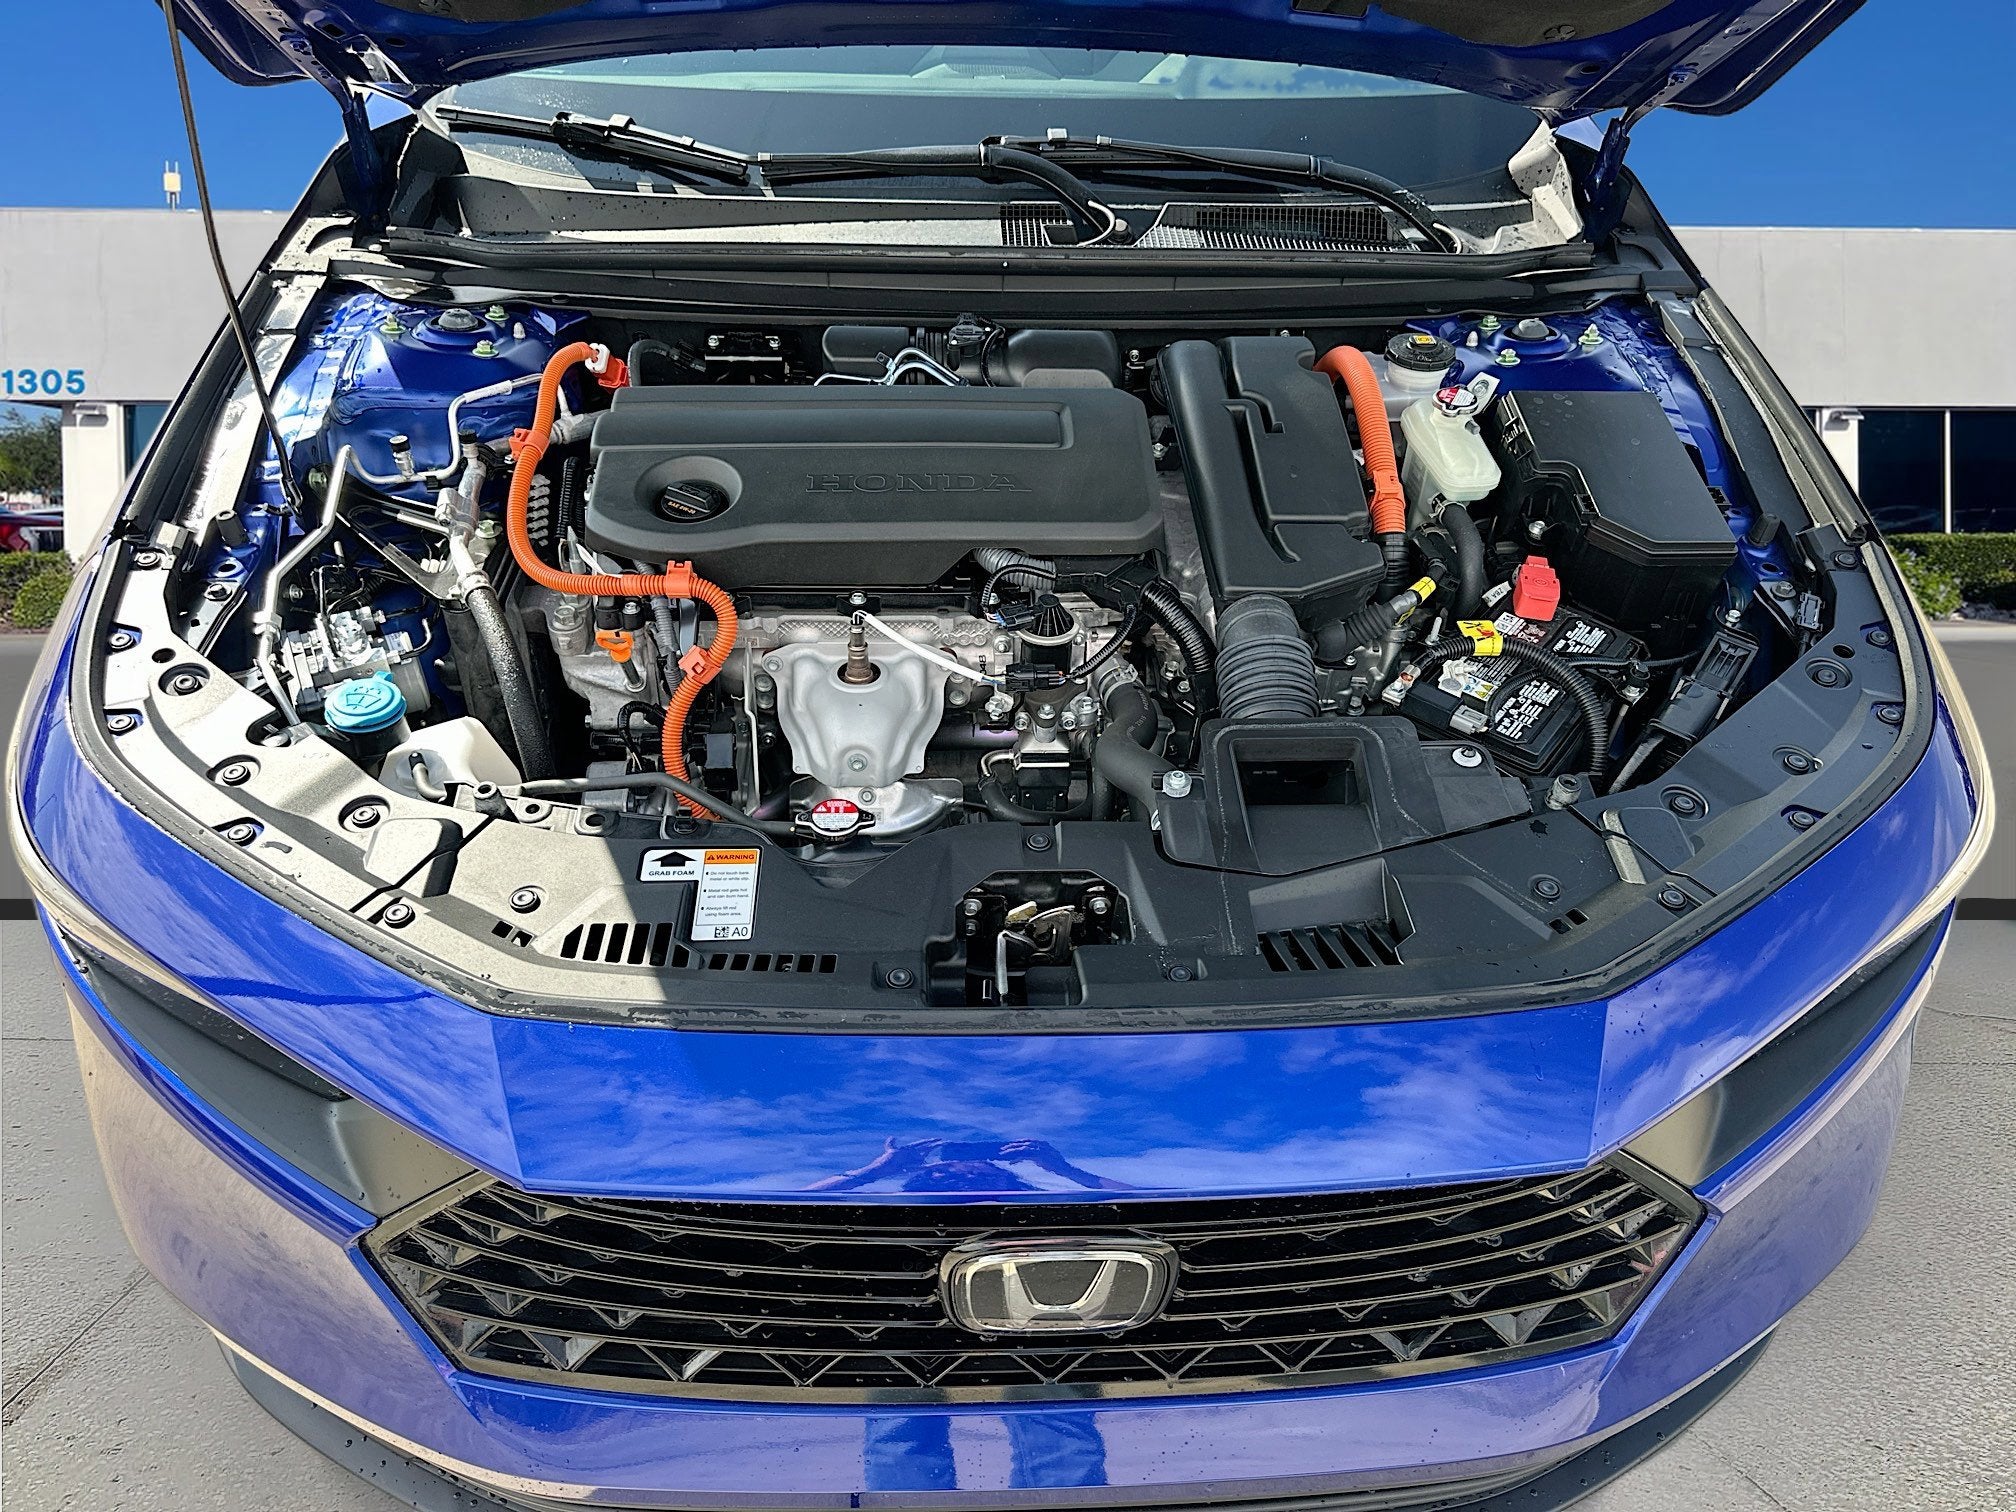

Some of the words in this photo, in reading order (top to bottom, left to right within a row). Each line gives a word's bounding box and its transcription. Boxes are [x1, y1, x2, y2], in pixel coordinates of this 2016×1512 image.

[1, 368, 85, 395] 1305
[805, 473, 1032, 493] HONDA
[731, 926, 748, 937] A0
